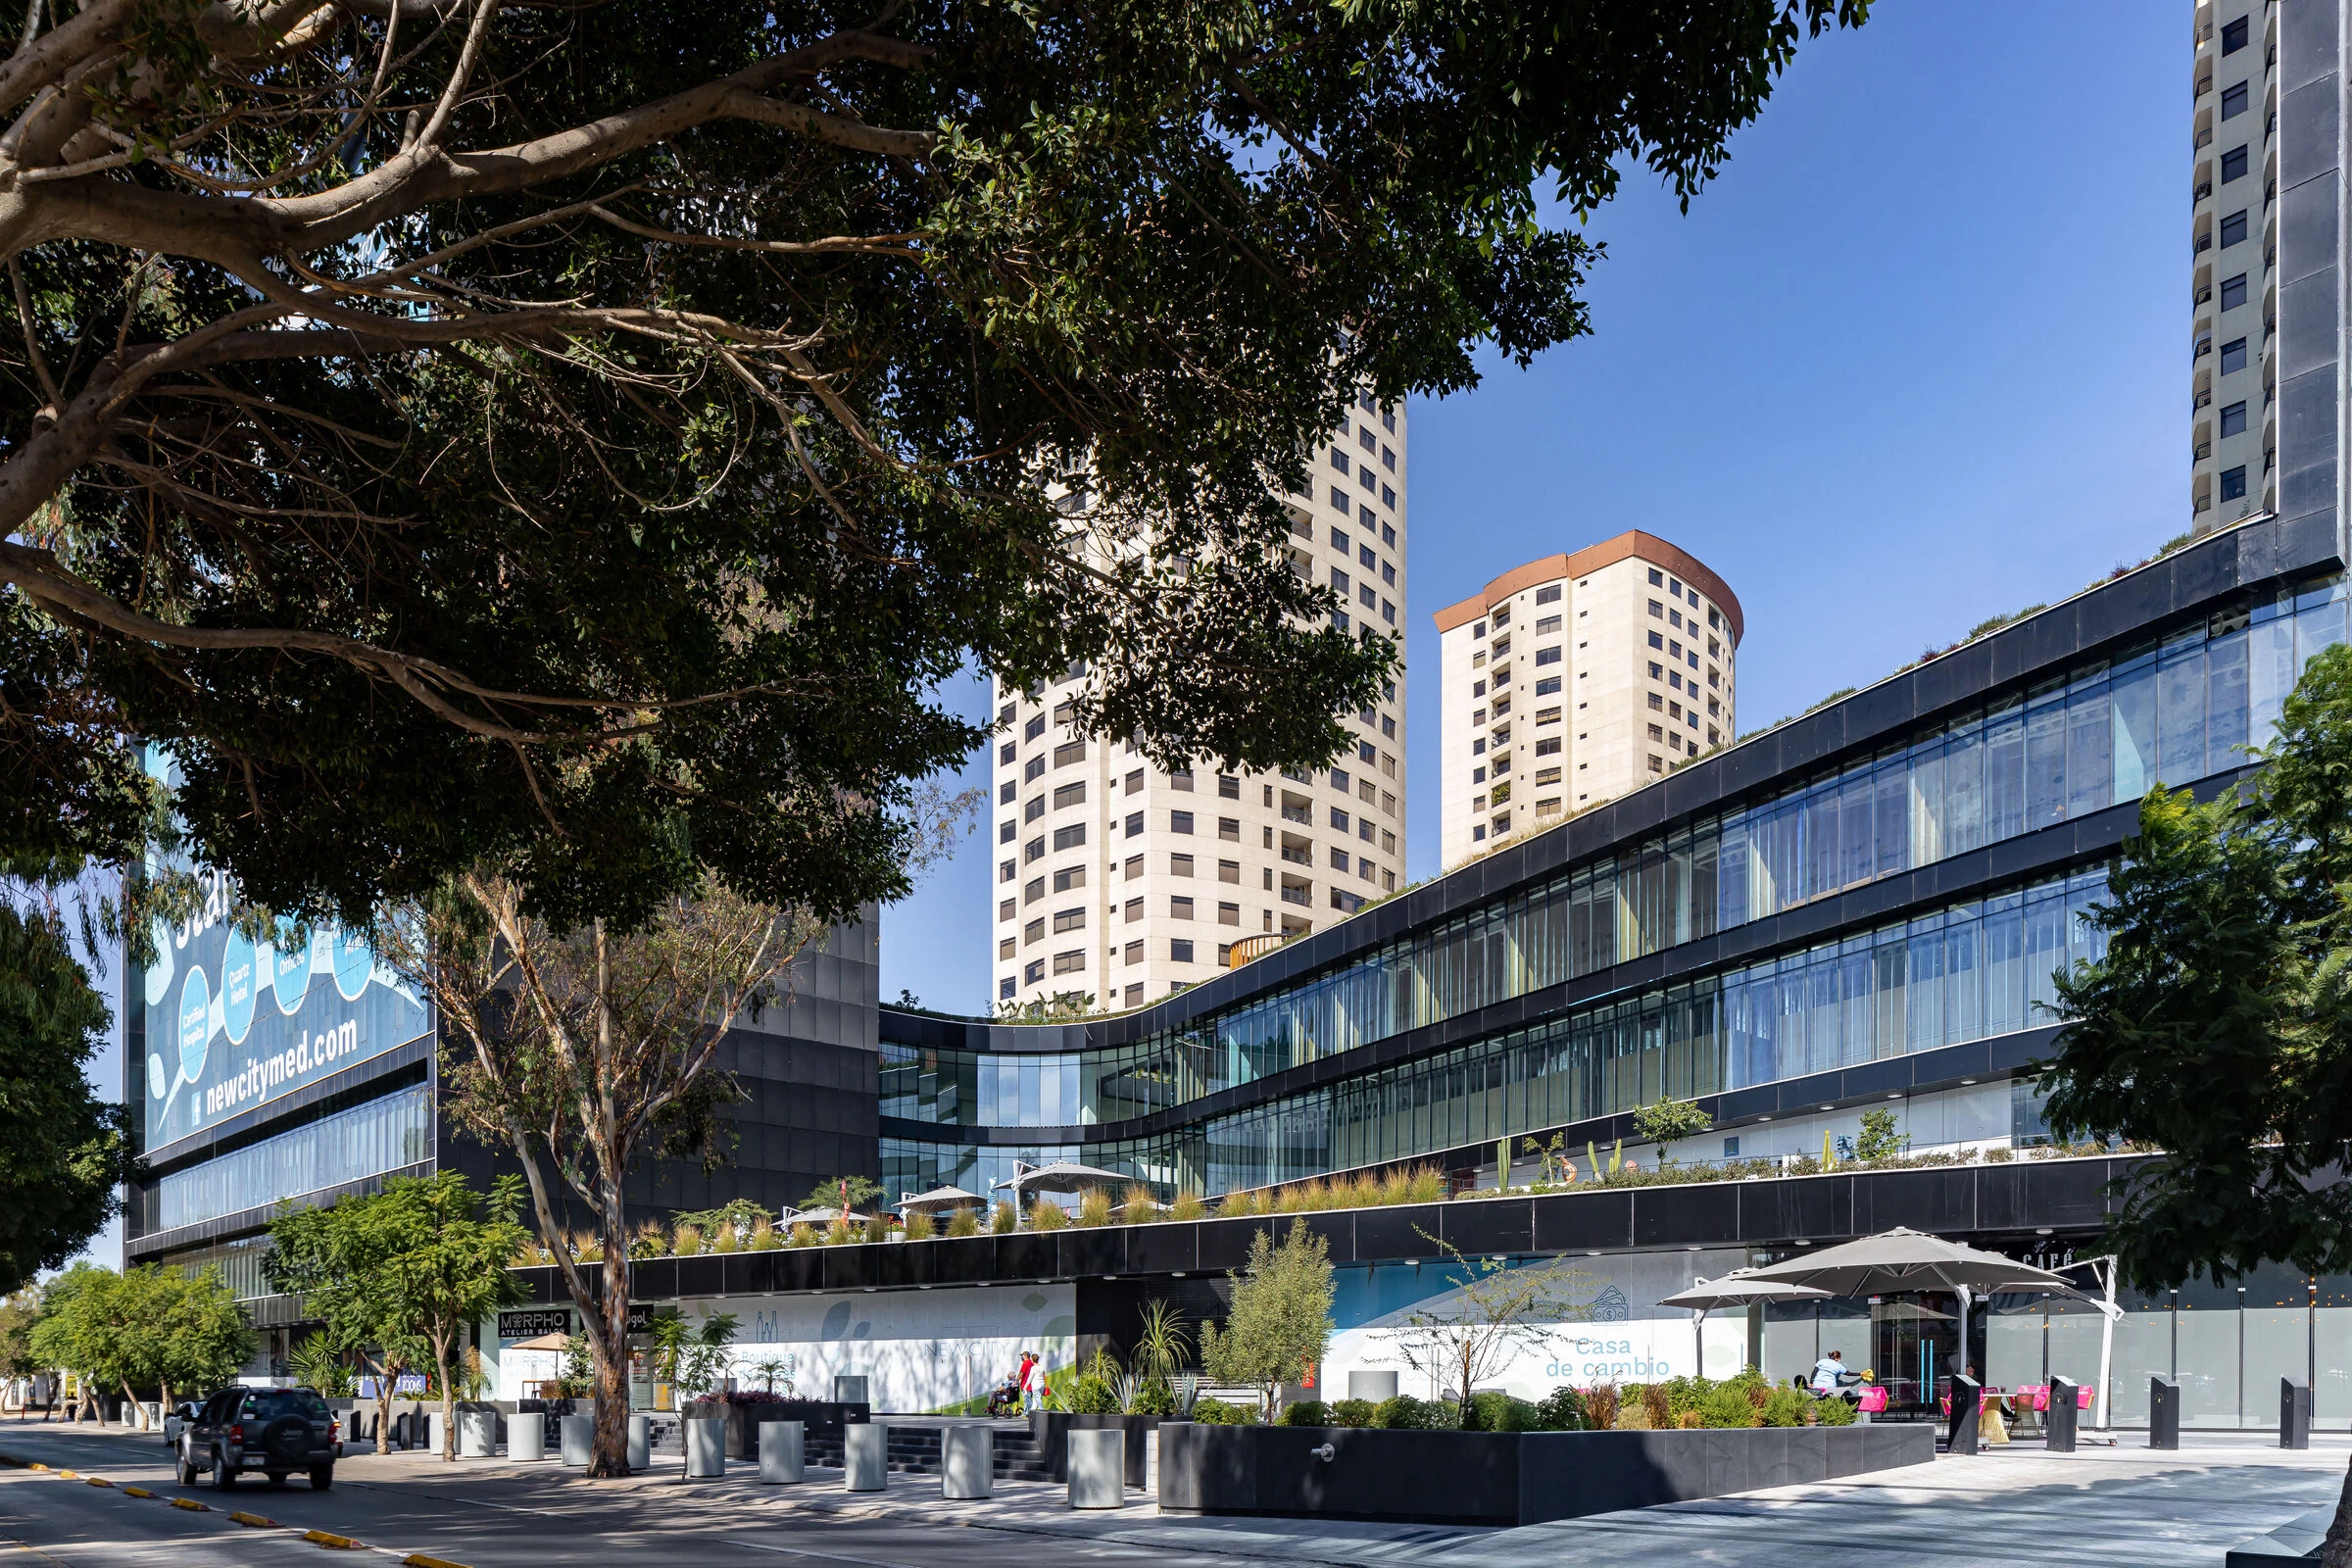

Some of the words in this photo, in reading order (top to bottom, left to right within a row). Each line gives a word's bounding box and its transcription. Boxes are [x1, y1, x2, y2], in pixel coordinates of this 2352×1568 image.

[207, 1018, 357, 1115] newcitymed.com
[924, 1341, 1010, 1356] NEWCITY
[1576, 1338, 1631, 1354] Casa
[742, 1350, 795, 1365] Boutique
[1546, 1356, 1573, 1377] de
[1583, 1356, 1669, 1377] cambio
